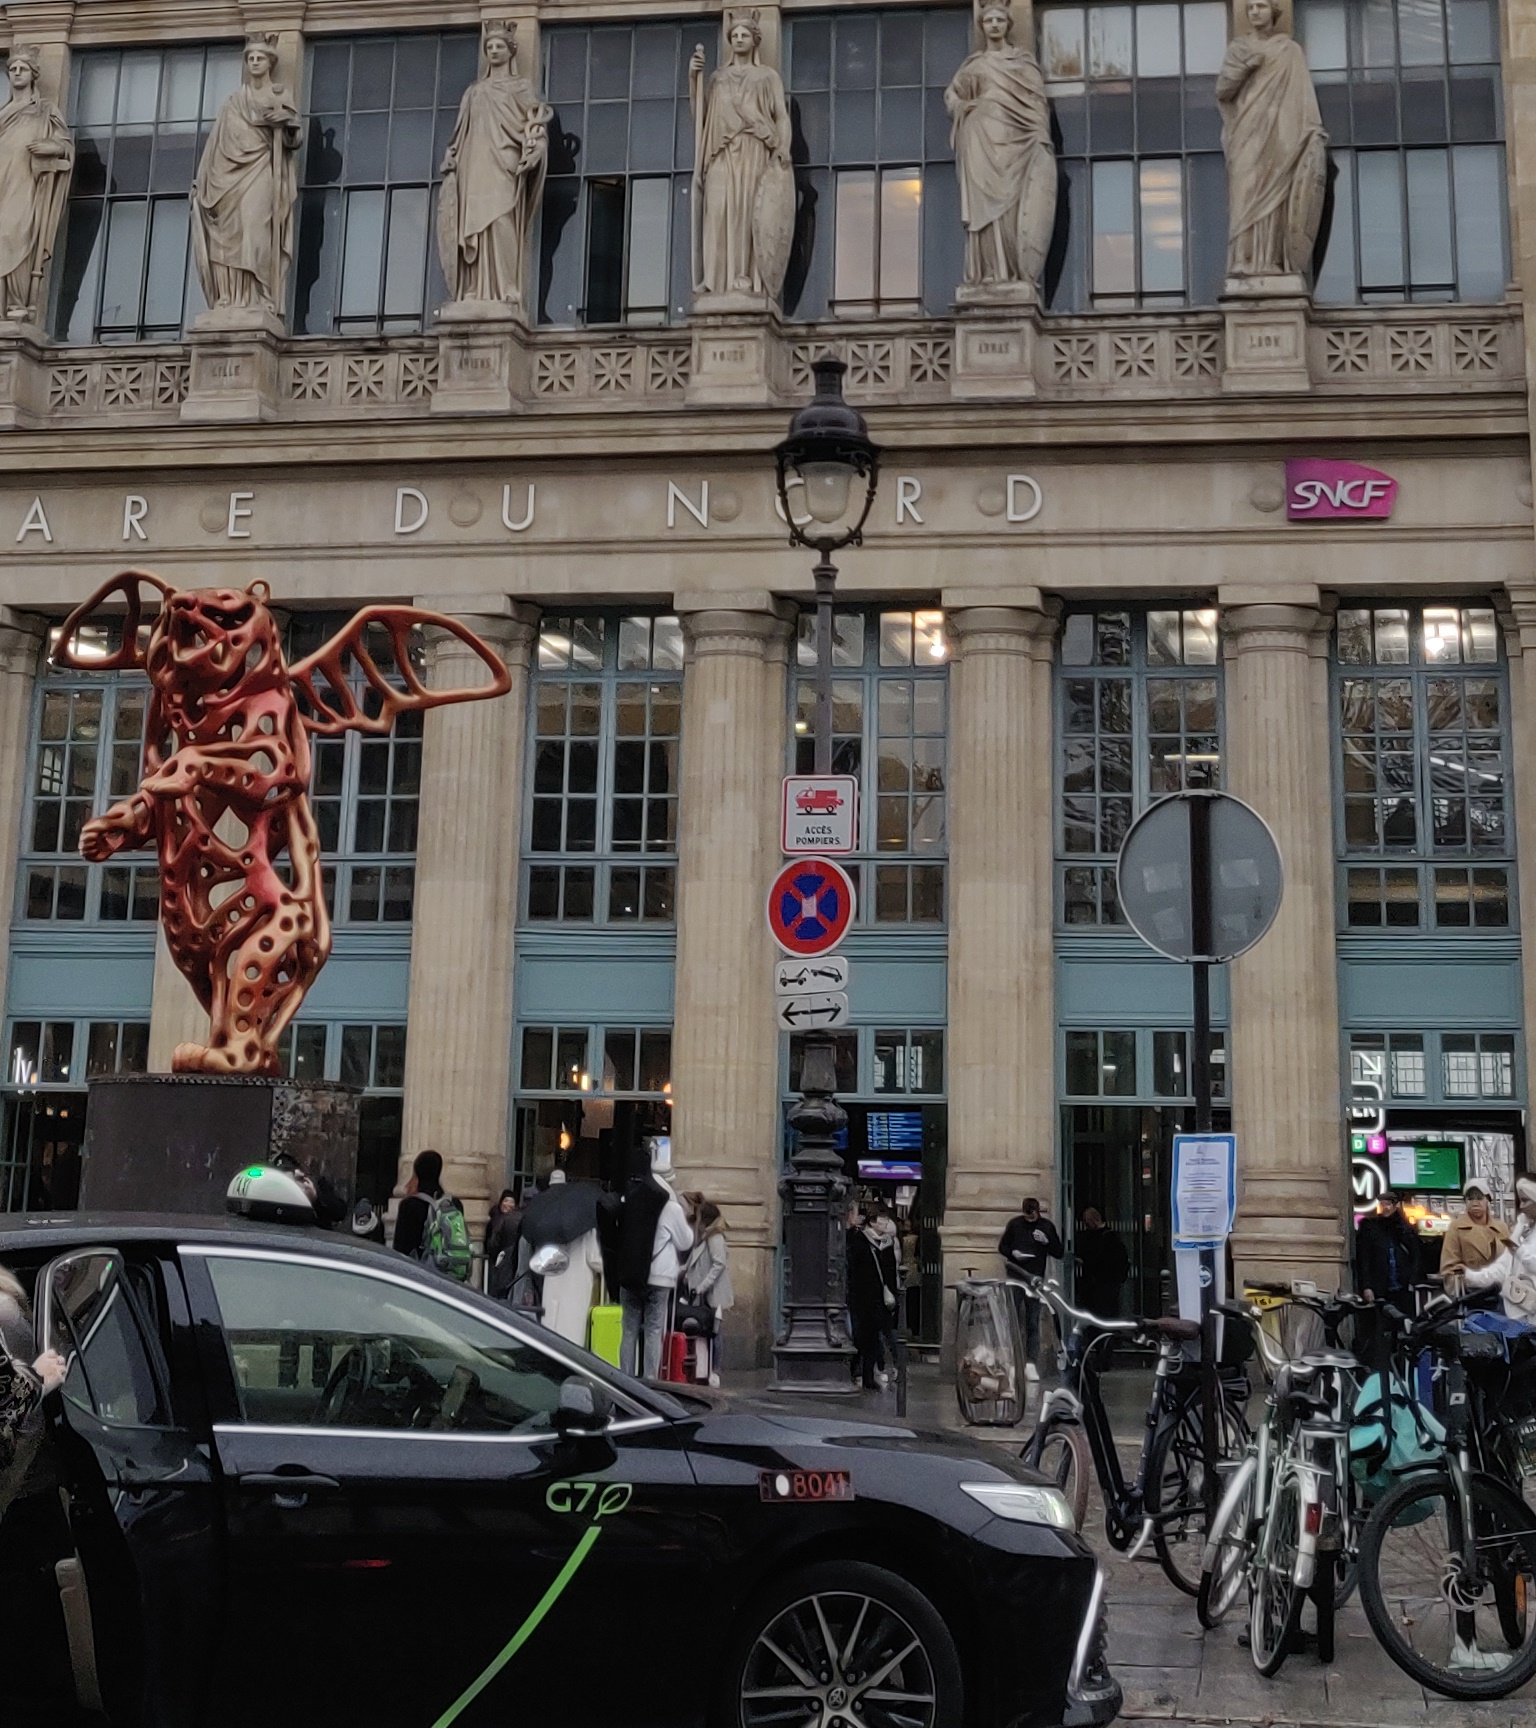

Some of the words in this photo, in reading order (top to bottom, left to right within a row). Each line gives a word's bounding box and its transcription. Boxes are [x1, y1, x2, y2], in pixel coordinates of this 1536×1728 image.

[394, 484, 536, 534] DU
[1290, 479, 1392, 510] SNCF
[1354, 1139, 1363, 1149] D
[545, 1481, 597, 1513] G7
[793, 1472, 846, 1498] 8041
